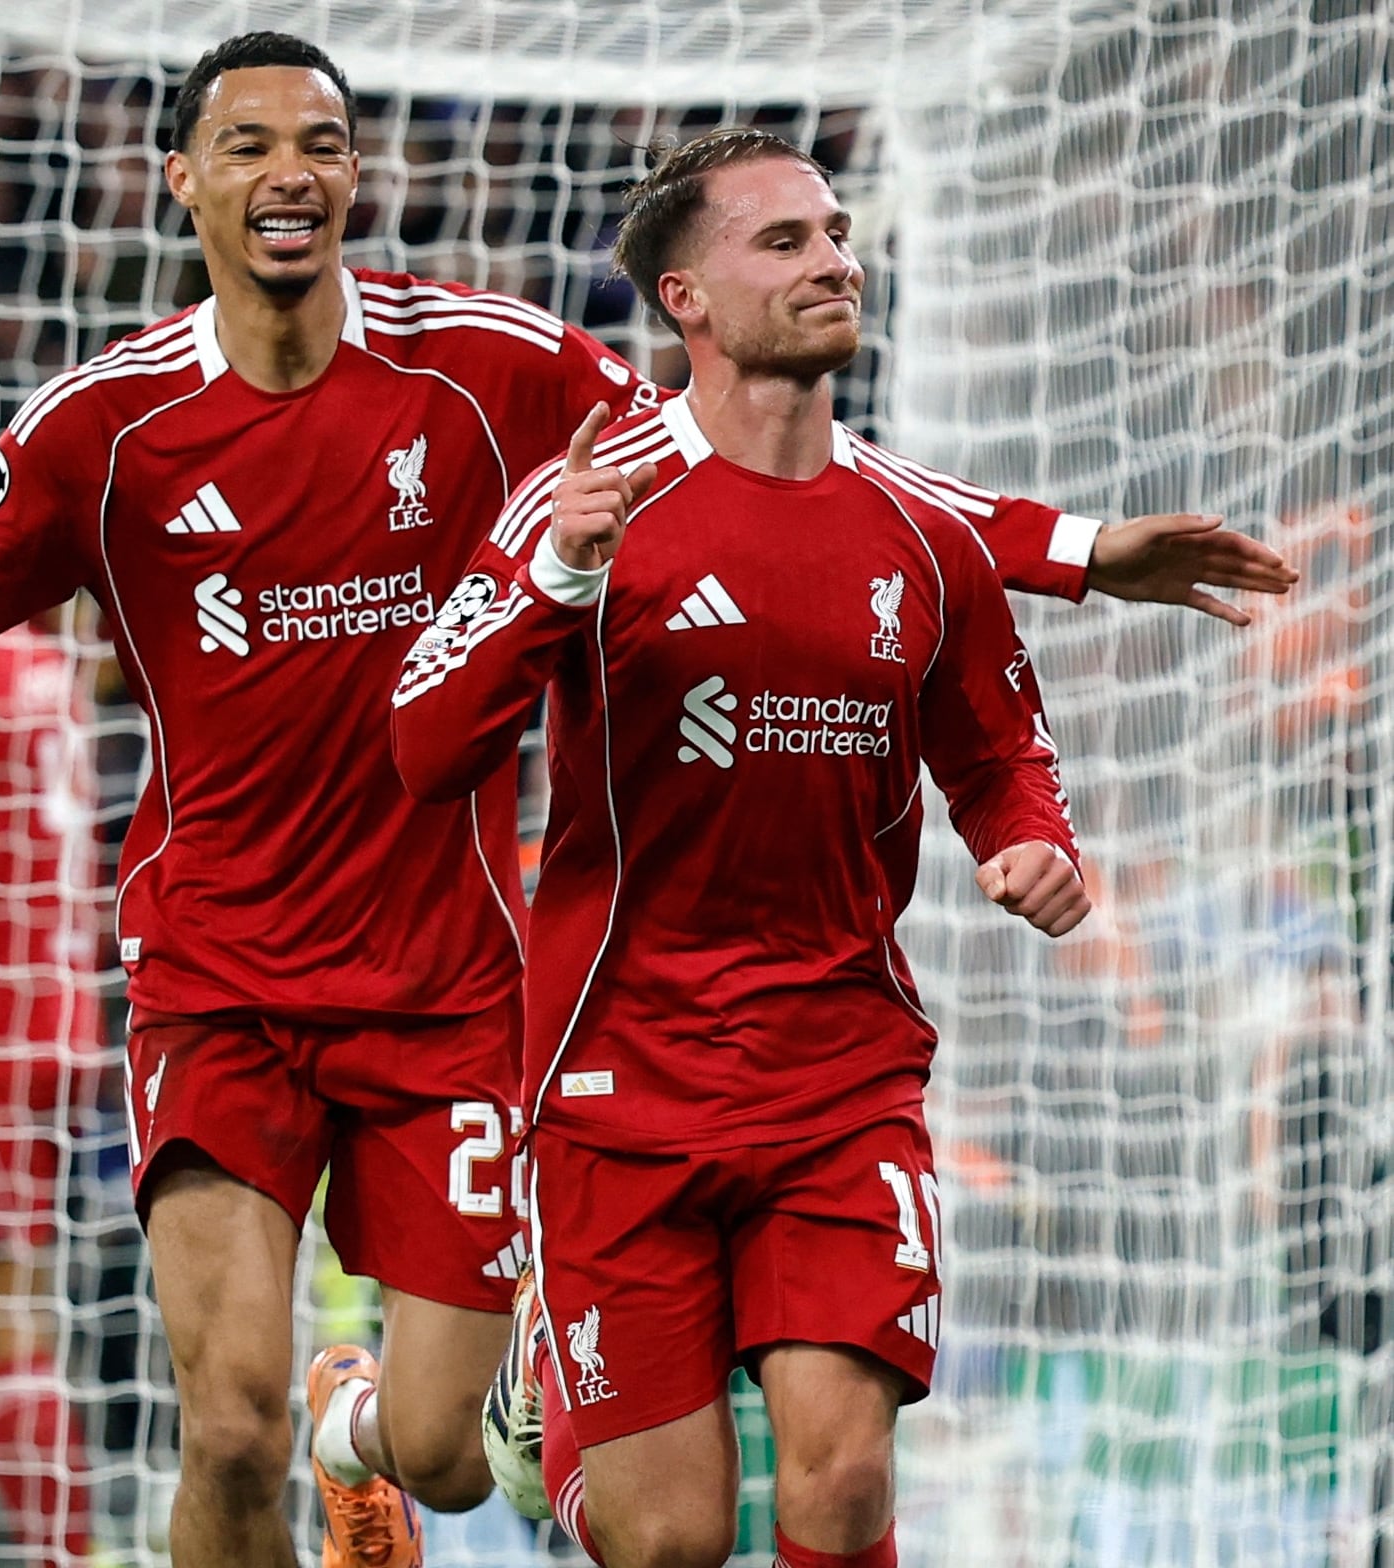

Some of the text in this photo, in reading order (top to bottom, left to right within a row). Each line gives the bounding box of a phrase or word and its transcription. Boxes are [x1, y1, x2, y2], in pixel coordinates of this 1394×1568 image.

[388, 507, 434, 532] L.F.C.
[258, 564, 422, 613] standard
[262, 592, 435, 642] chartered
[870, 638, 906, 664] L.F.C.
[749, 689, 894, 729] standard
[745, 721, 891, 757] chartered
[576, 1379, 618, 1406] L.F.C.
